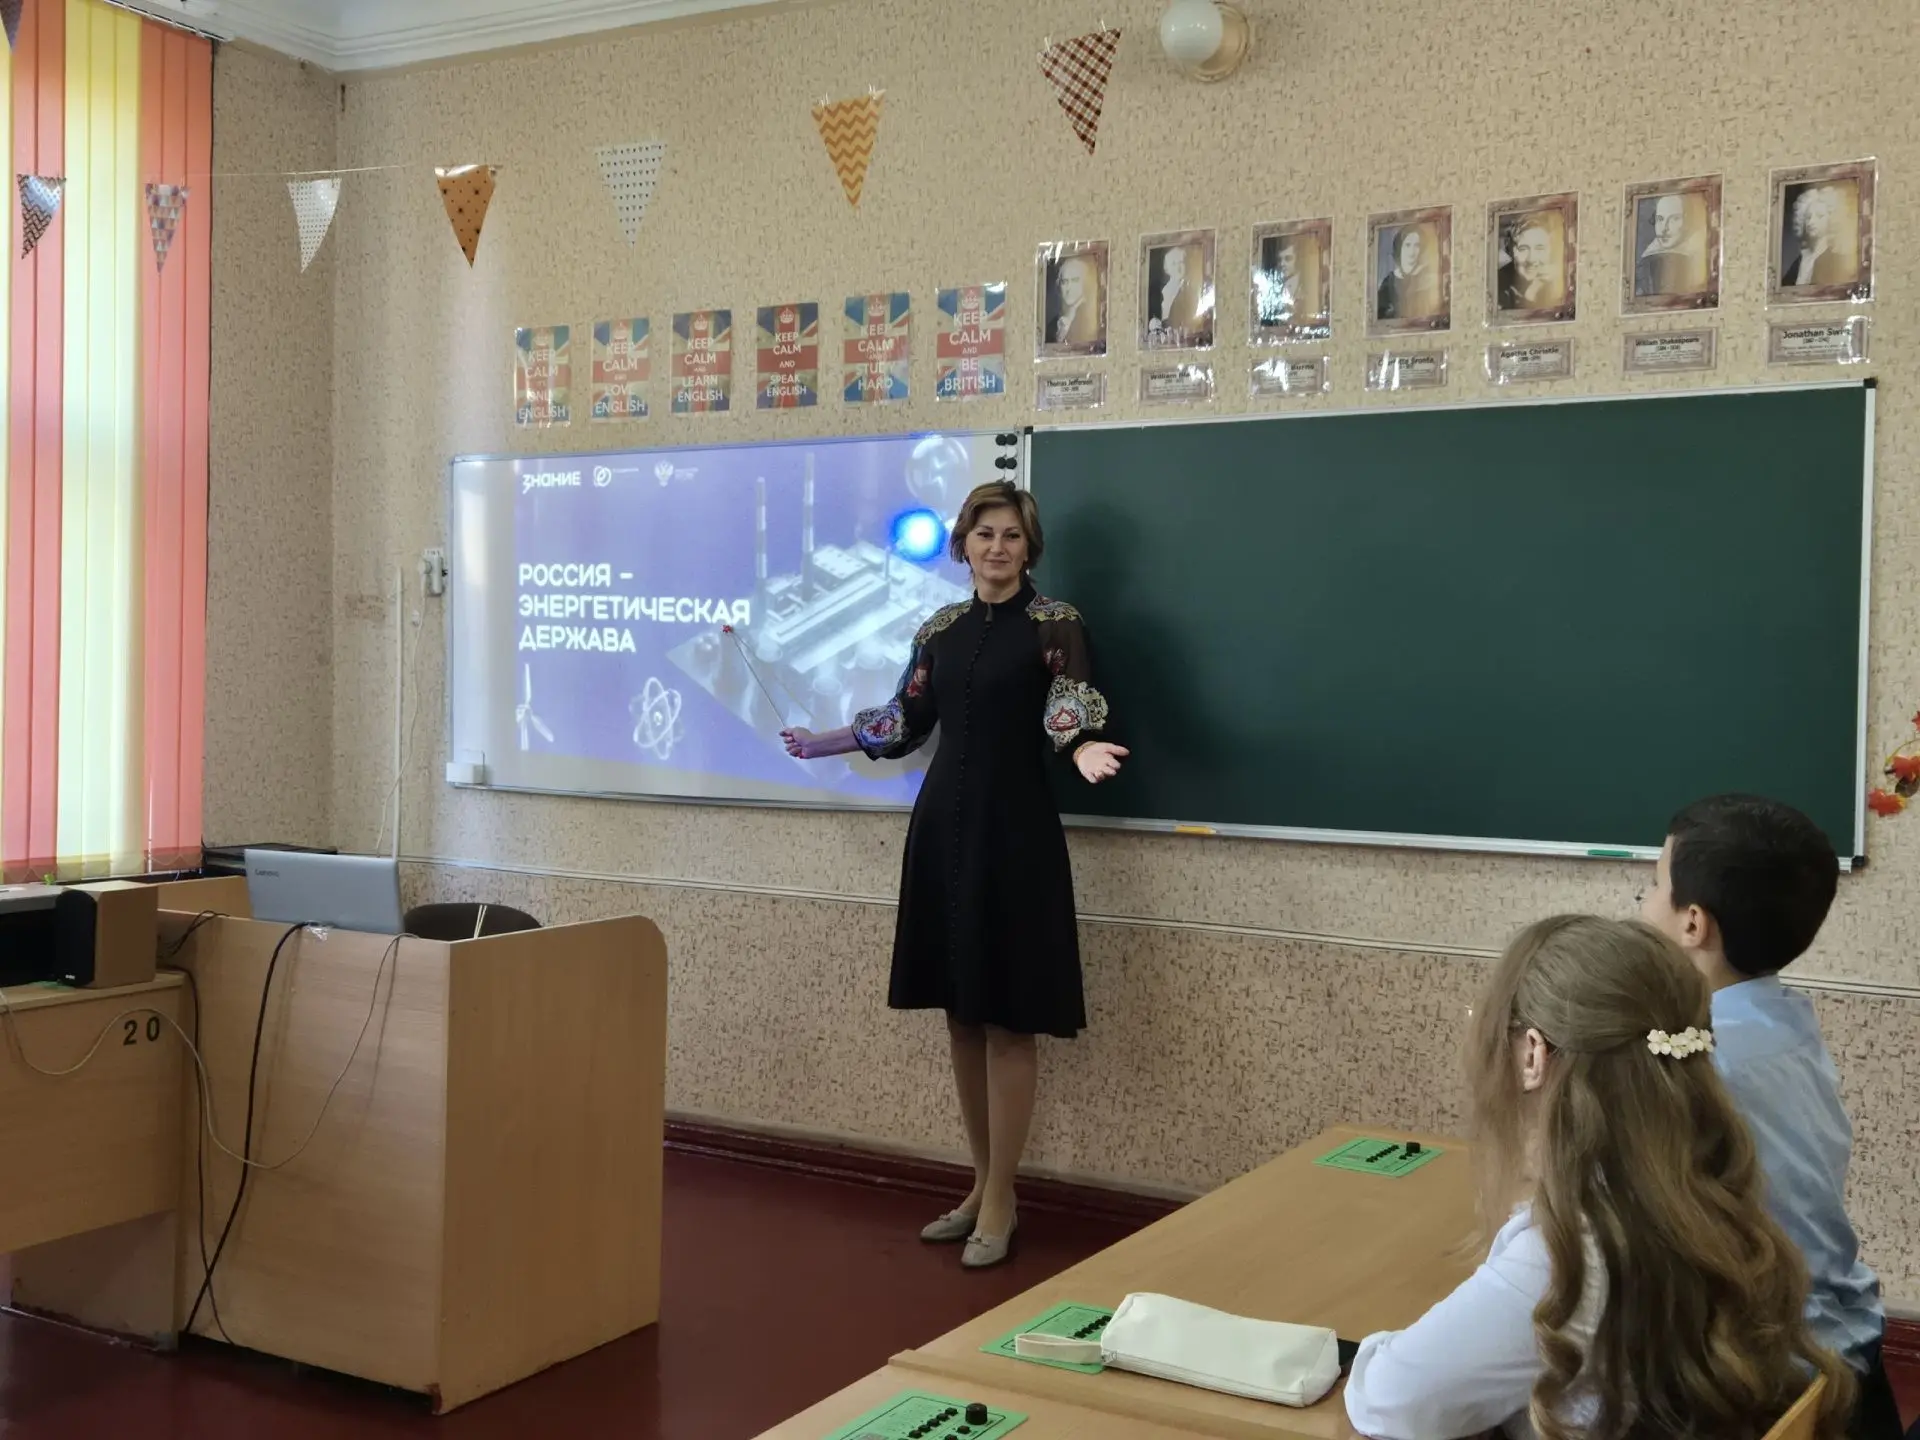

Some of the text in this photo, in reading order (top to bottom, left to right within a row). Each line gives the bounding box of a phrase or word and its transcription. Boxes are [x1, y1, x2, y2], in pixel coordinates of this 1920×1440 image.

[953, 311, 988, 326] KEEP
[860, 323, 893, 337] KEEP
[949, 329, 991, 345] CALM
[1783, 329, 1825, 339] Jonathan
[687, 337, 715, 350] KEEP
[775, 332, 799, 343] KEEP
[606, 341, 635, 356] KEEP
[773, 344, 801, 355] CALM
[858, 338, 895, 352] CALM
[528, 349, 556, 363] KEEP
[684, 354, 717, 365] CALM
[1500, 349, 1528, 360] Agatha
[1529, 346, 1559, 357] Christie
[526, 365, 559, 378] CALM
[602, 359, 638, 372] CALM
[962, 358, 978, 371] BE
[682, 374, 718, 388] LEARN
[770, 374, 801, 385] SPEAK
[944, 375, 996, 391] BRITISH
[1150, 371, 1177, 381] William
[858, 377, 894, 391] HARD
[1046, 379, 1067, 388] Thomas
[677, 388, 723, 403] ENGLISH
[766, 385, 807, 398] ENGLISH
[518, 405, 566, 420] ENGLISH
[595, 399, 645, 414] ENGLISH
[518, 562, 612, 588] РОССИЯ
[518, 593, 751, 626] ЭНЕРГЕТИЧЕСКАЯ
[518, 625, 637, 652] ДЕРЖАВА
[123, 1016, 160, 1046] 20
